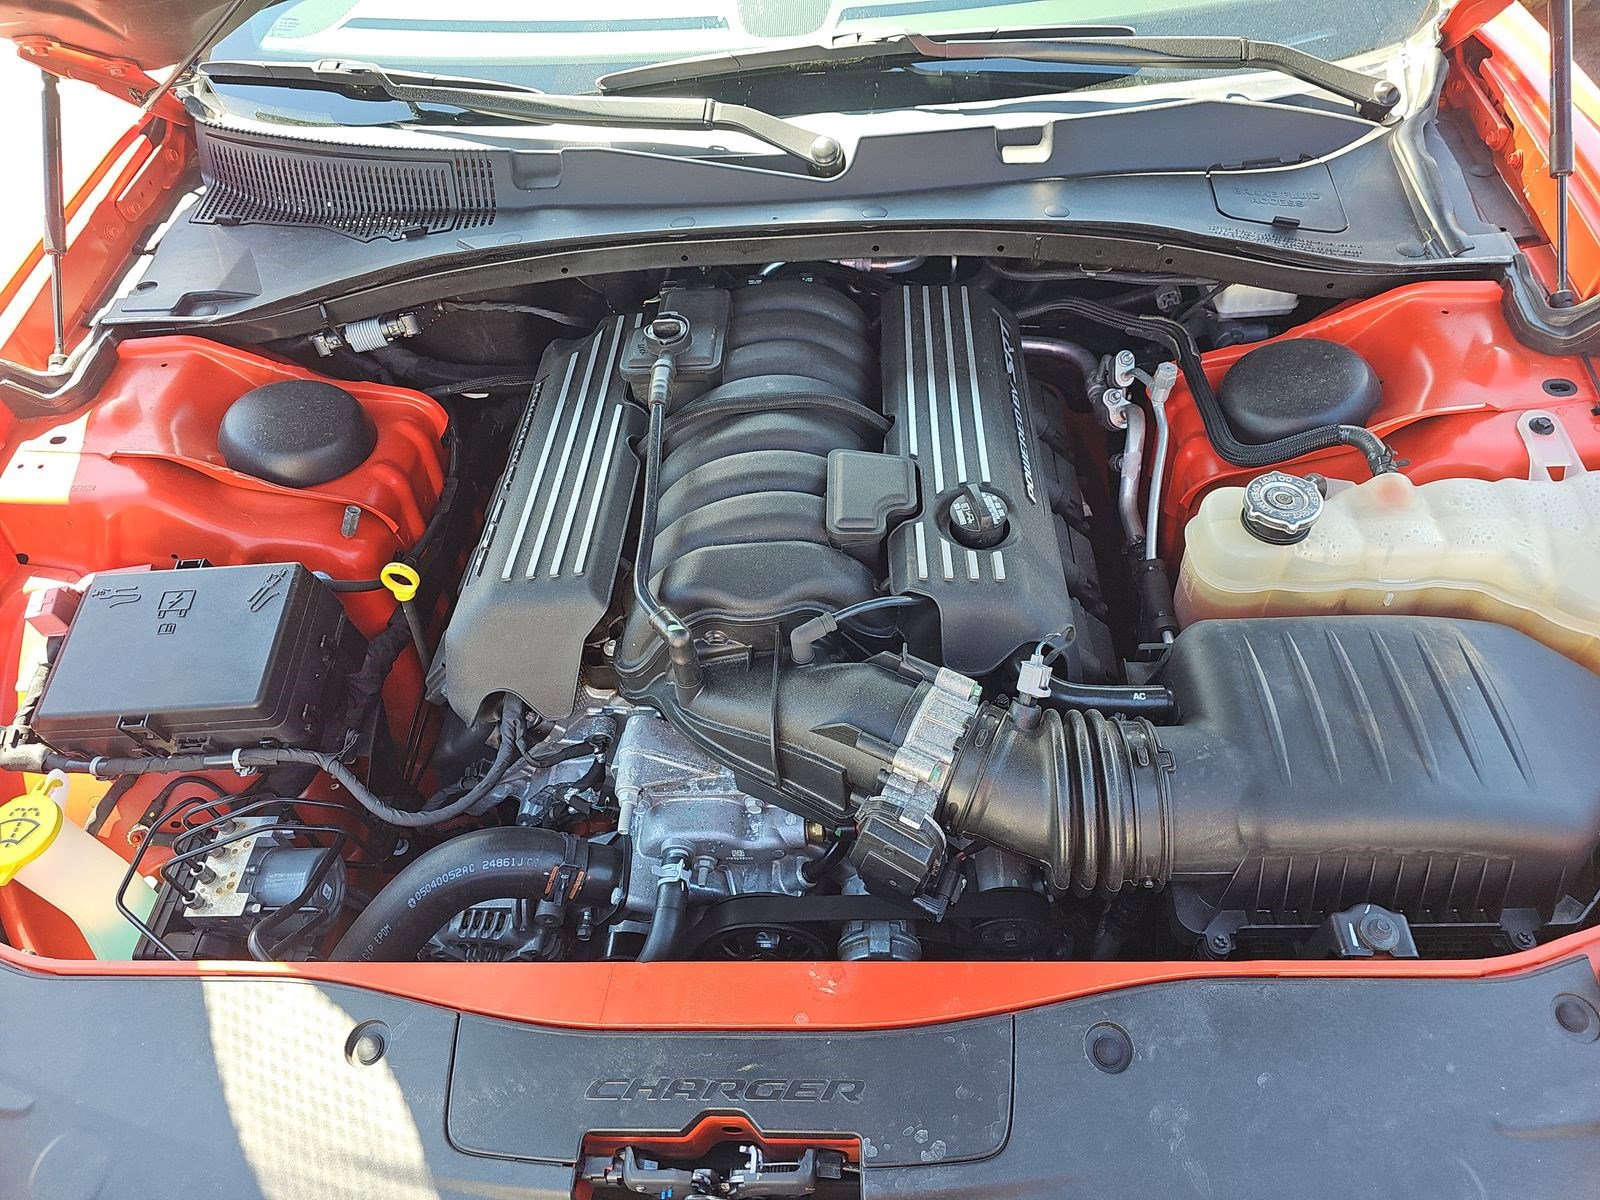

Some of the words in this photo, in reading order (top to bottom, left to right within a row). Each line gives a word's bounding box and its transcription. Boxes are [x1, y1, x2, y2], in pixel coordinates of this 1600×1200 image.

[1250, 198, 1305, 208] ACCESS
[1280, 191, 1320, 200] FLUID
[997, 313, 1017, 384] SRT
[1009, 382, 1020, 407] BY
[1013, 408, 1037, 504] POWERED
[1259, 475, 1278, 486] NOT
[1277, 475, 1293, 483] DO
[1133, 692, 1147, 701] AC
[414, 863, 476, 901] 05040052AC
[374, 922, 392, 945] EPDM
[584, 1078, 867, 1103] CHARGER
